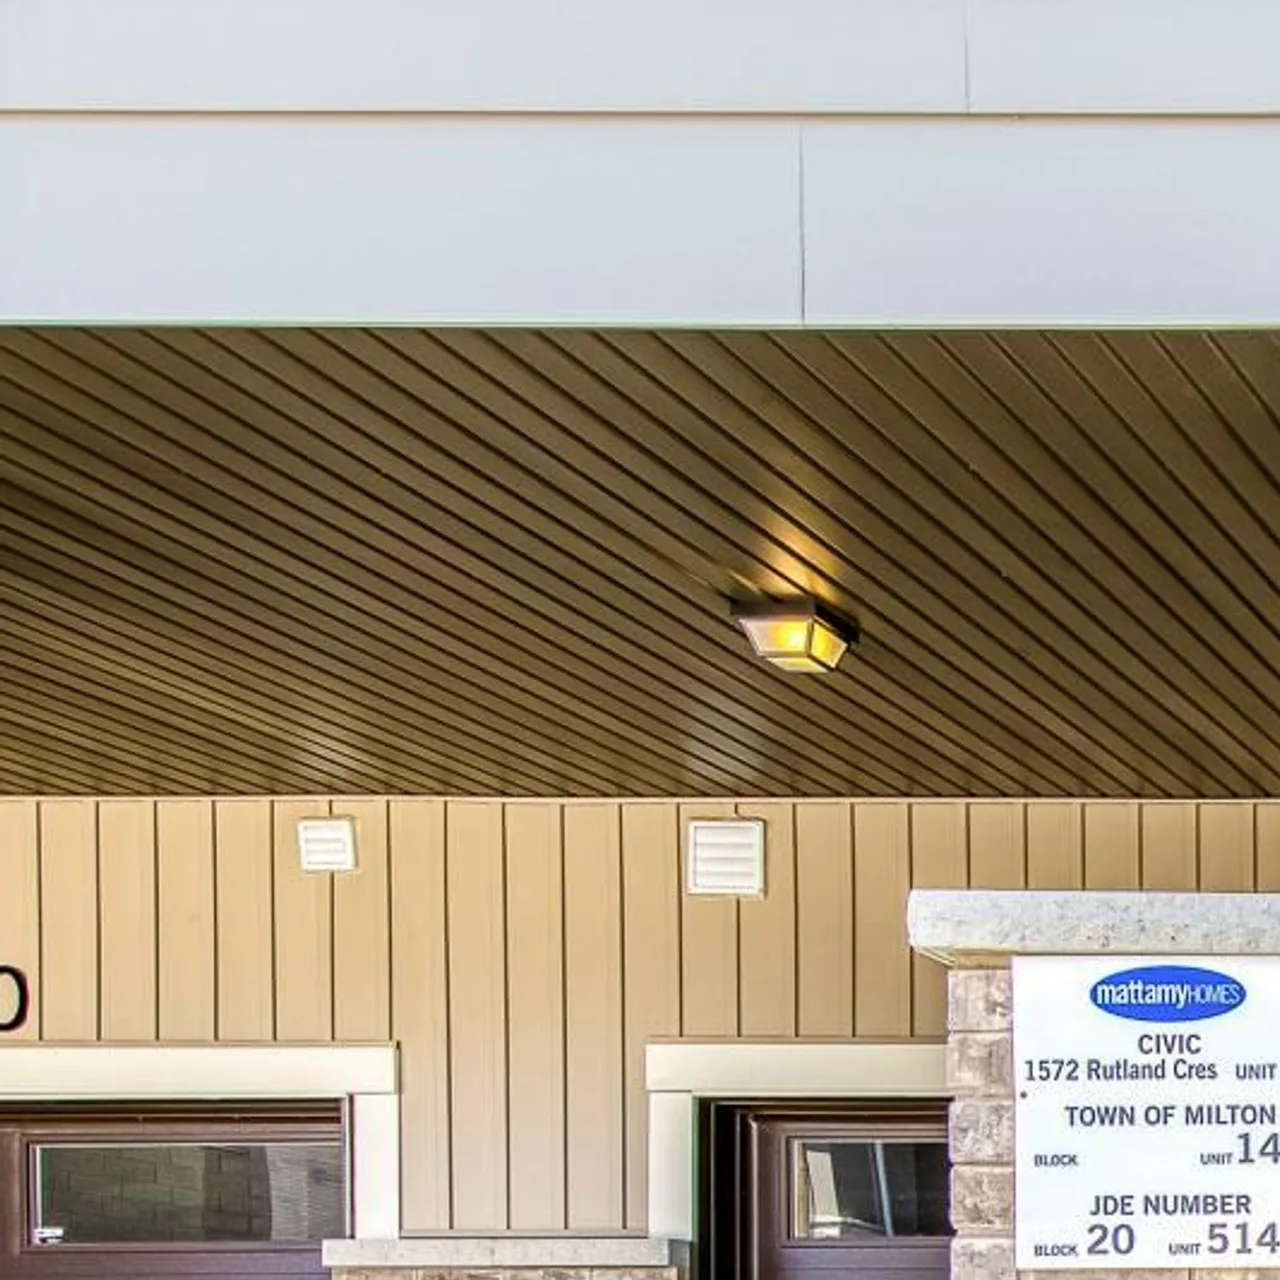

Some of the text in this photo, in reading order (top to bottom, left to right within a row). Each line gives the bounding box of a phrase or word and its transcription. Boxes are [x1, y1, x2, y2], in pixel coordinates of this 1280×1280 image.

[1137, 1033, 1202, 1056] CIVIC
[1024, 1057, 1277, 1082] 1572 Rutland Cres UNIT
[1063, 1103, 1277, 1128] TOWN OF MILTON
[1033, 1153, 1079, 1168] BLOCK
[1199, 1152, 1233, 1167] UNIT
[1089, 1194, 1252, 1217] JDE NUMBER
[1033, 1244, 1079, 1258] BLOCK
[1086, 1223, 1136, 1256] 20
[1168, 1242, 1202, 1257] UNIT
